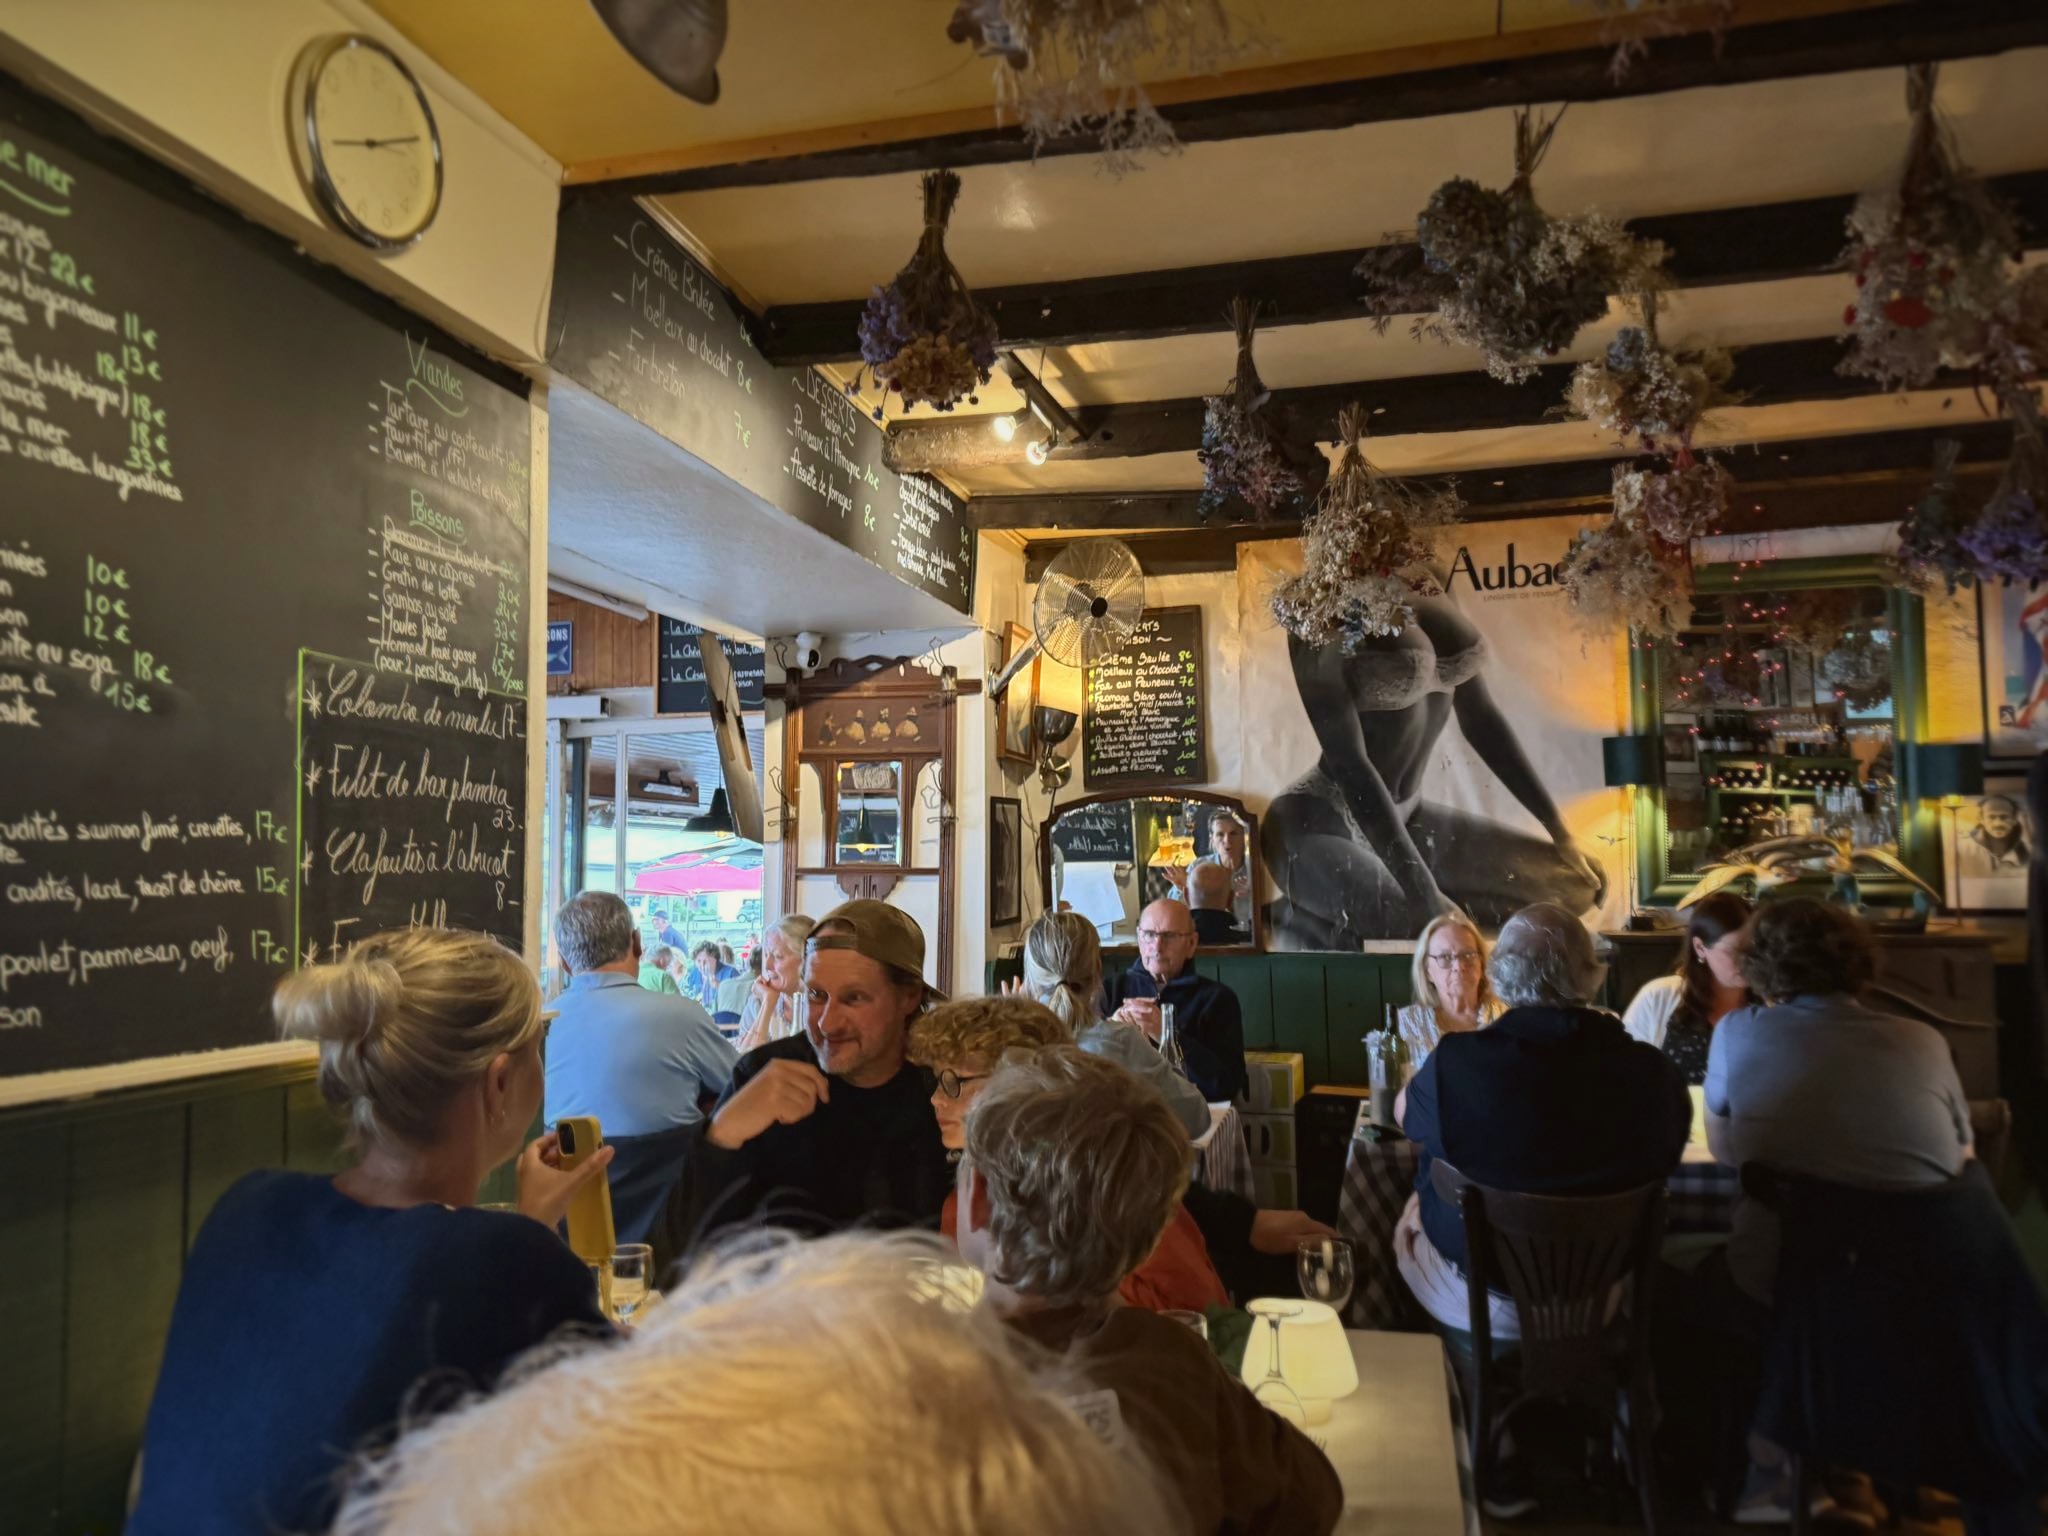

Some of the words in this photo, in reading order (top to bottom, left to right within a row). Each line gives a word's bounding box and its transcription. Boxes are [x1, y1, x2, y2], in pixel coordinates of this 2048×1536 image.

[124, 311, 158, 351] 11€
[122, 343, 162, 382] 13€
[404, 329, 464, 402] Viandes
[737, 359, 753, 395] 8€
[379, 379, 430, 434] Tartare
[434, 422, 448, 442] au
[805, 364, 857, 435] DESSERTS
[26, 415, 71, 446] mer
[410, 487, 465, 537] Poissons
[87, 553, 131, 589] 10€
[381, 561, 419, 591] Gratin
[421, 573, 436, 597] de
[415, 554, 438, 576] aux
[85, 587, 131, 619] 10€
[382, 583, 424, 616] Gambas
[83, 613, 131, 645] 12€
[381, 603, 418, 642] Moules
[134, 648, 174, 684] 18€
[669, 642, 682, 658] La
[1178, 650, 1193, 662] 8€
[670, 665, 683, 681] La
[1148, 663, 1183, 675] Chocolat
[1178, 675, 1195, 687] 7€
[104, 680, 152, 713] 15€
[423, 695, 441, 727] de
[386, 759, 410, 797] de
[76, 821, 141, 841] saumon
[140, 810, 188, 853] fumé,
[188, 812, 252, 846] crevettes,
[255, 809, 289, 843] 17€
[6, 871, 83, 913] crudités,
[179, 869, 198, 896] de
[256, 865, 290, 896] 15€
[0, 938, 79, 993] poulet,
[79, 942, 187, 984] parmesan,
[251, 928, 289, 965] 17€
